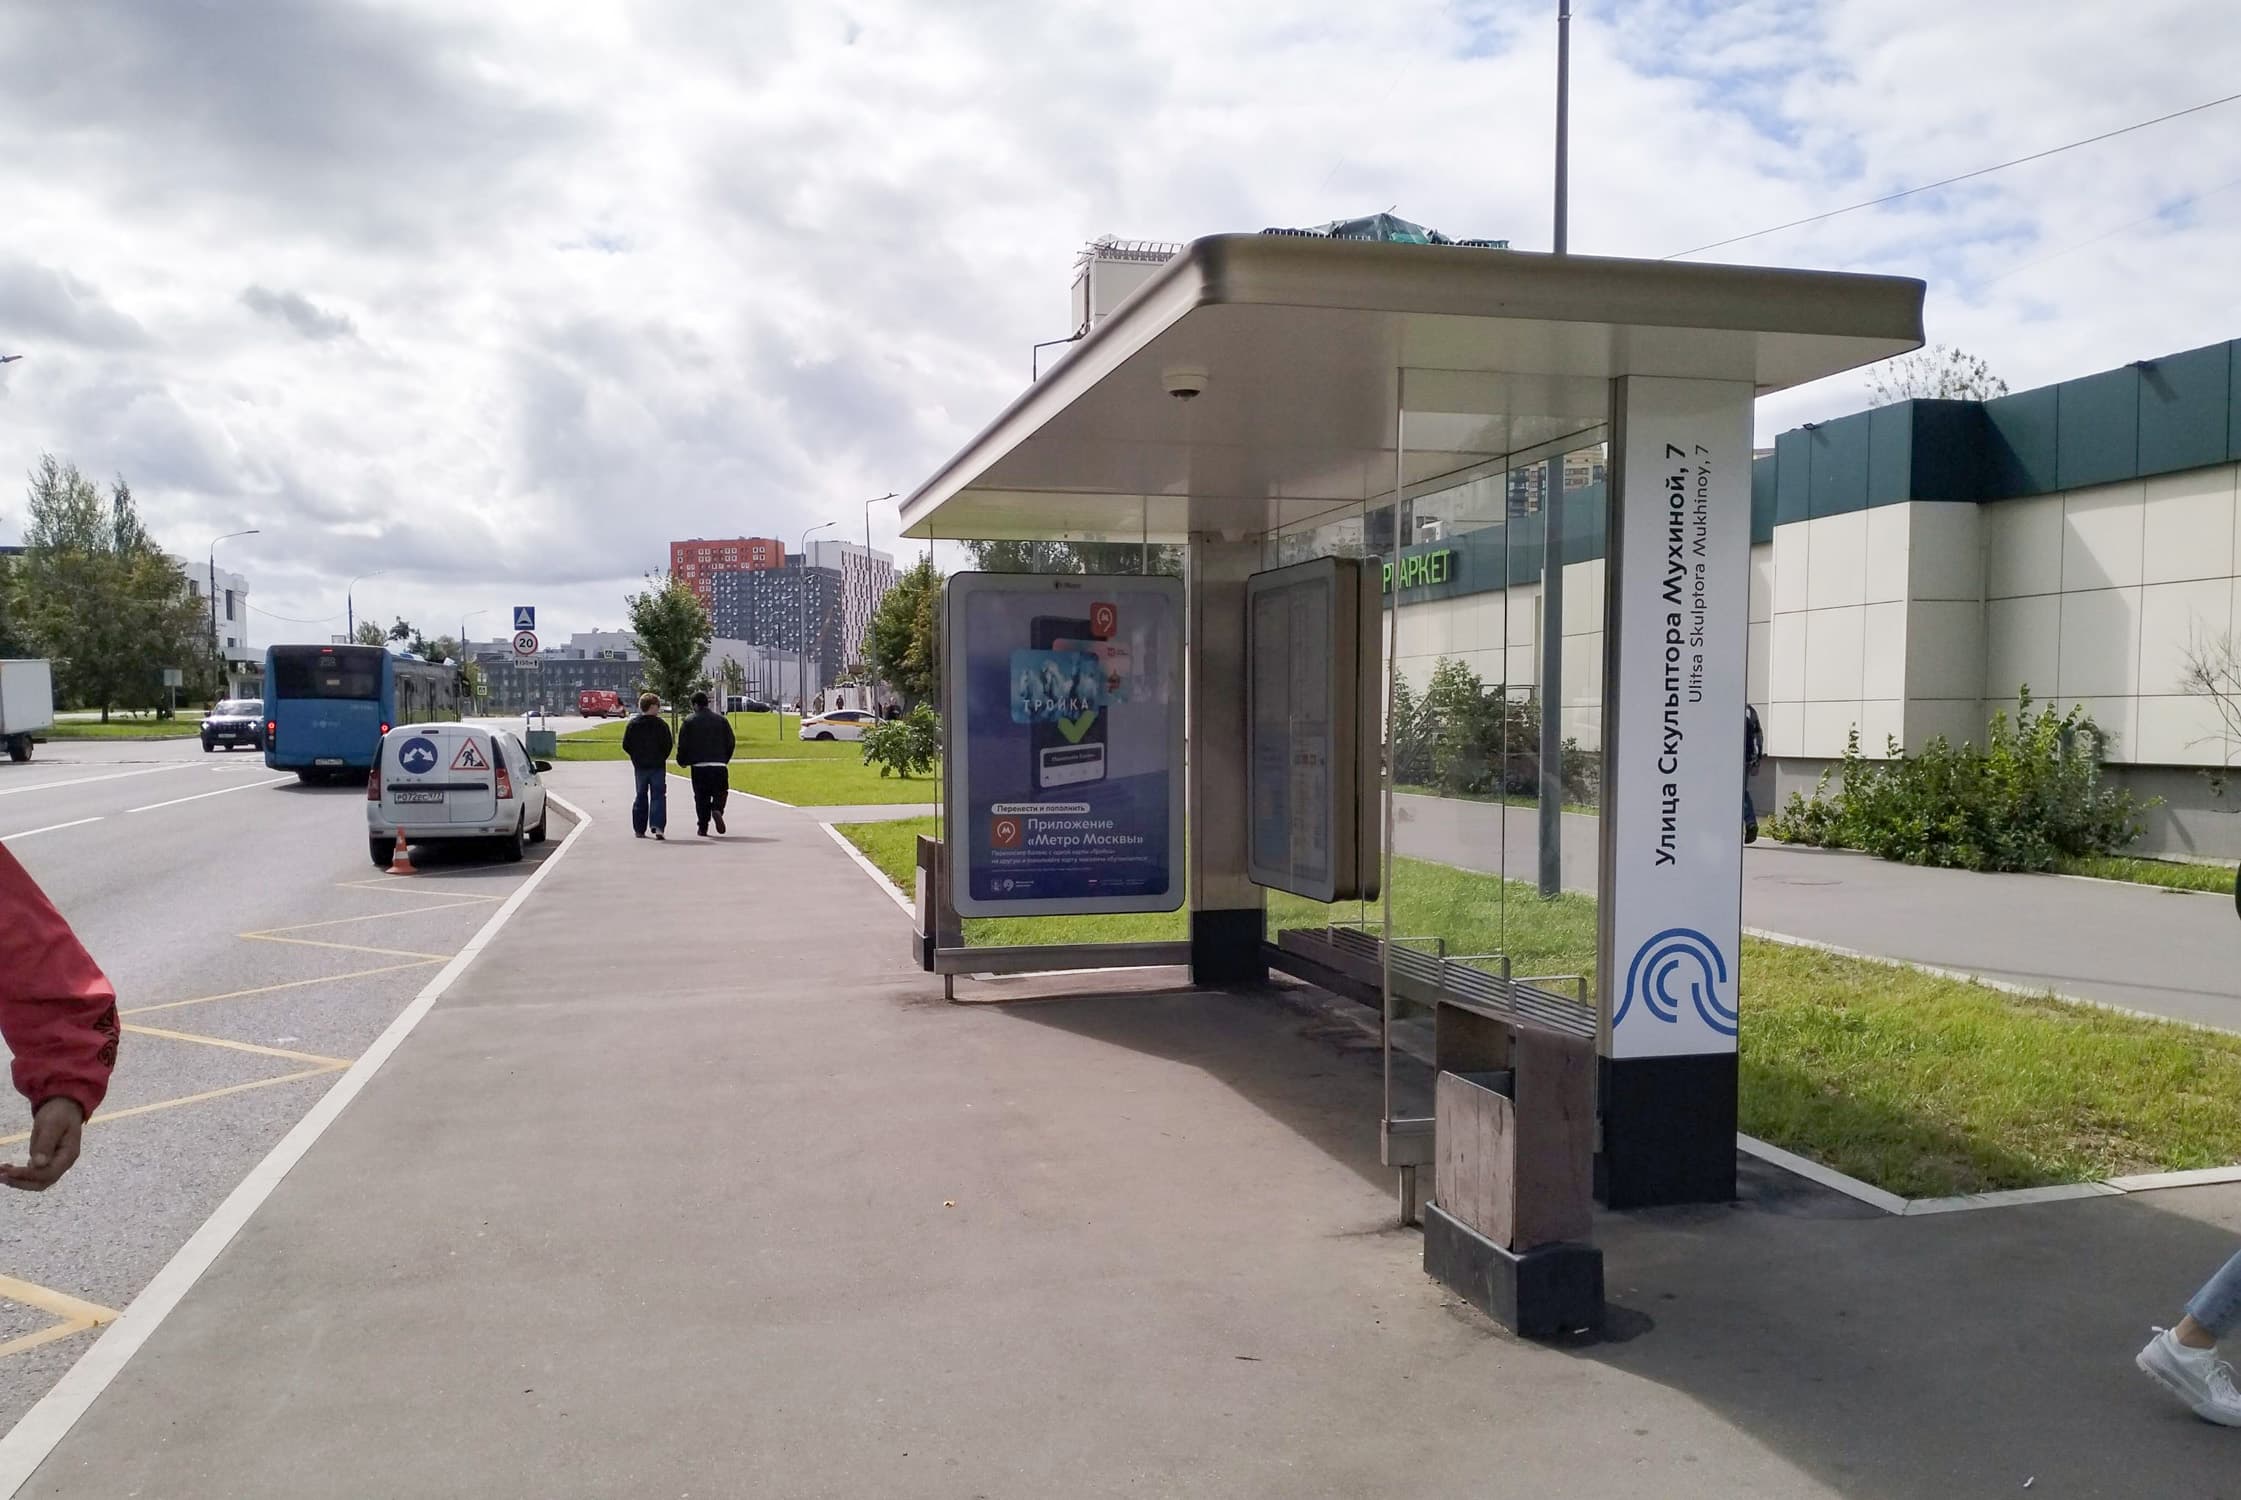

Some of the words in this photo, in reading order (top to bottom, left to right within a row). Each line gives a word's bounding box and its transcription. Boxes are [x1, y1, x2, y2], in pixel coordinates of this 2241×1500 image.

[1665, 443, 1686, 459] 7
[1695, 444, 1709, 455] 7
[1692, 461, 1711, 557] Mukhinoy,
[1662, 468, 1689, 605] Мухиной,
[1690, 563, 1707, 647] Skulptora
[519, 638, 534, 648] 20
[1688, 654, 1704, 703] Ulitsa
[1657, 612, 1685, 775] Скульптора
[1023, 696, 1089, 712] ТРОЙКА
[997, 805, 1038, 813] Перенести
[1045, 805, 1086, 813] пополнить
[1027, 818, 1114, 831] Приложение
[1655, 783, 1680, 866] Улица
[1027, 834, 1080, 847] «Метро
[1083, 833, 1144, 845] Москвы»
